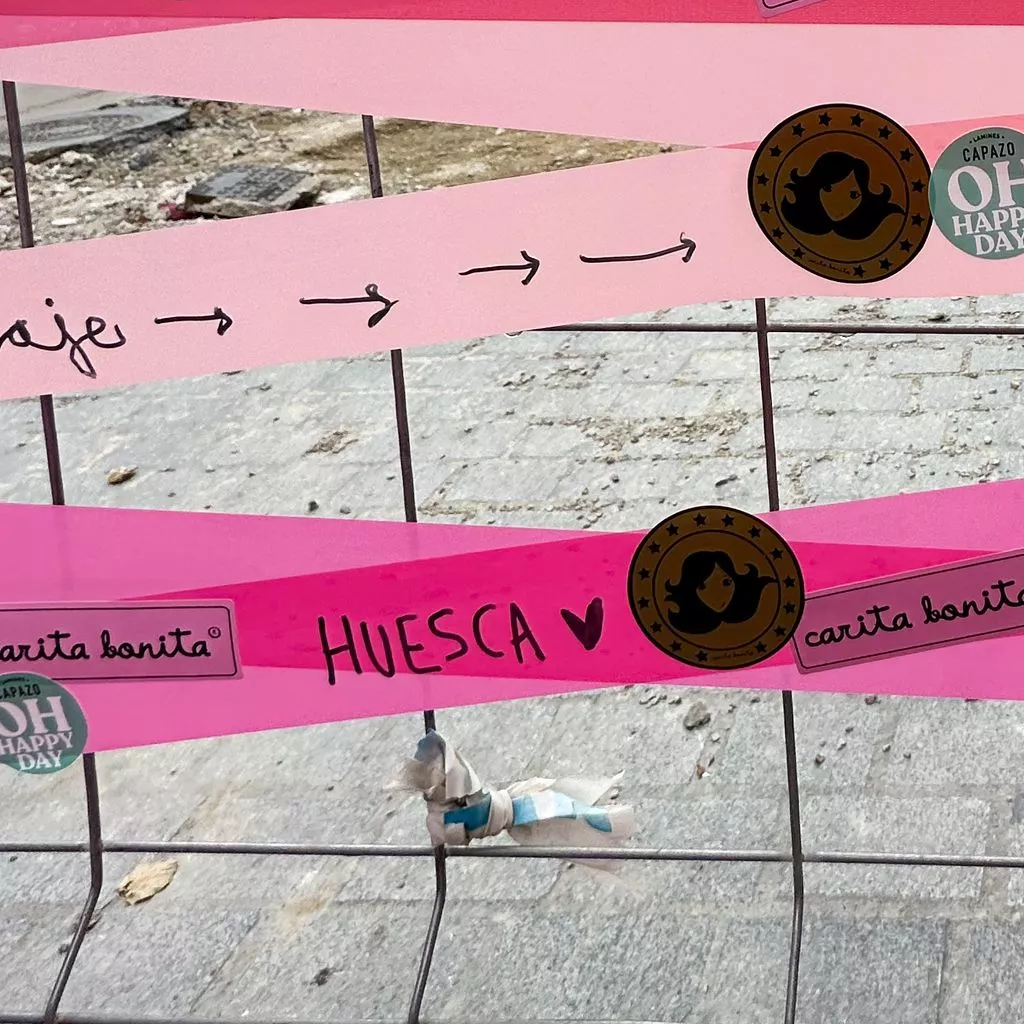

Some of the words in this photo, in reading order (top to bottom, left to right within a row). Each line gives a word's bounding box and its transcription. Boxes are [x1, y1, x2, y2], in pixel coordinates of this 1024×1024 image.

[963, 142, 1015, 163] CAPAZO
[805, 605, 913, 647] carita
[318, 603, 546, 685] HUESCA
[0, 732, 73, 756] HAPPY
[17, 750, 63, 771] DAY
